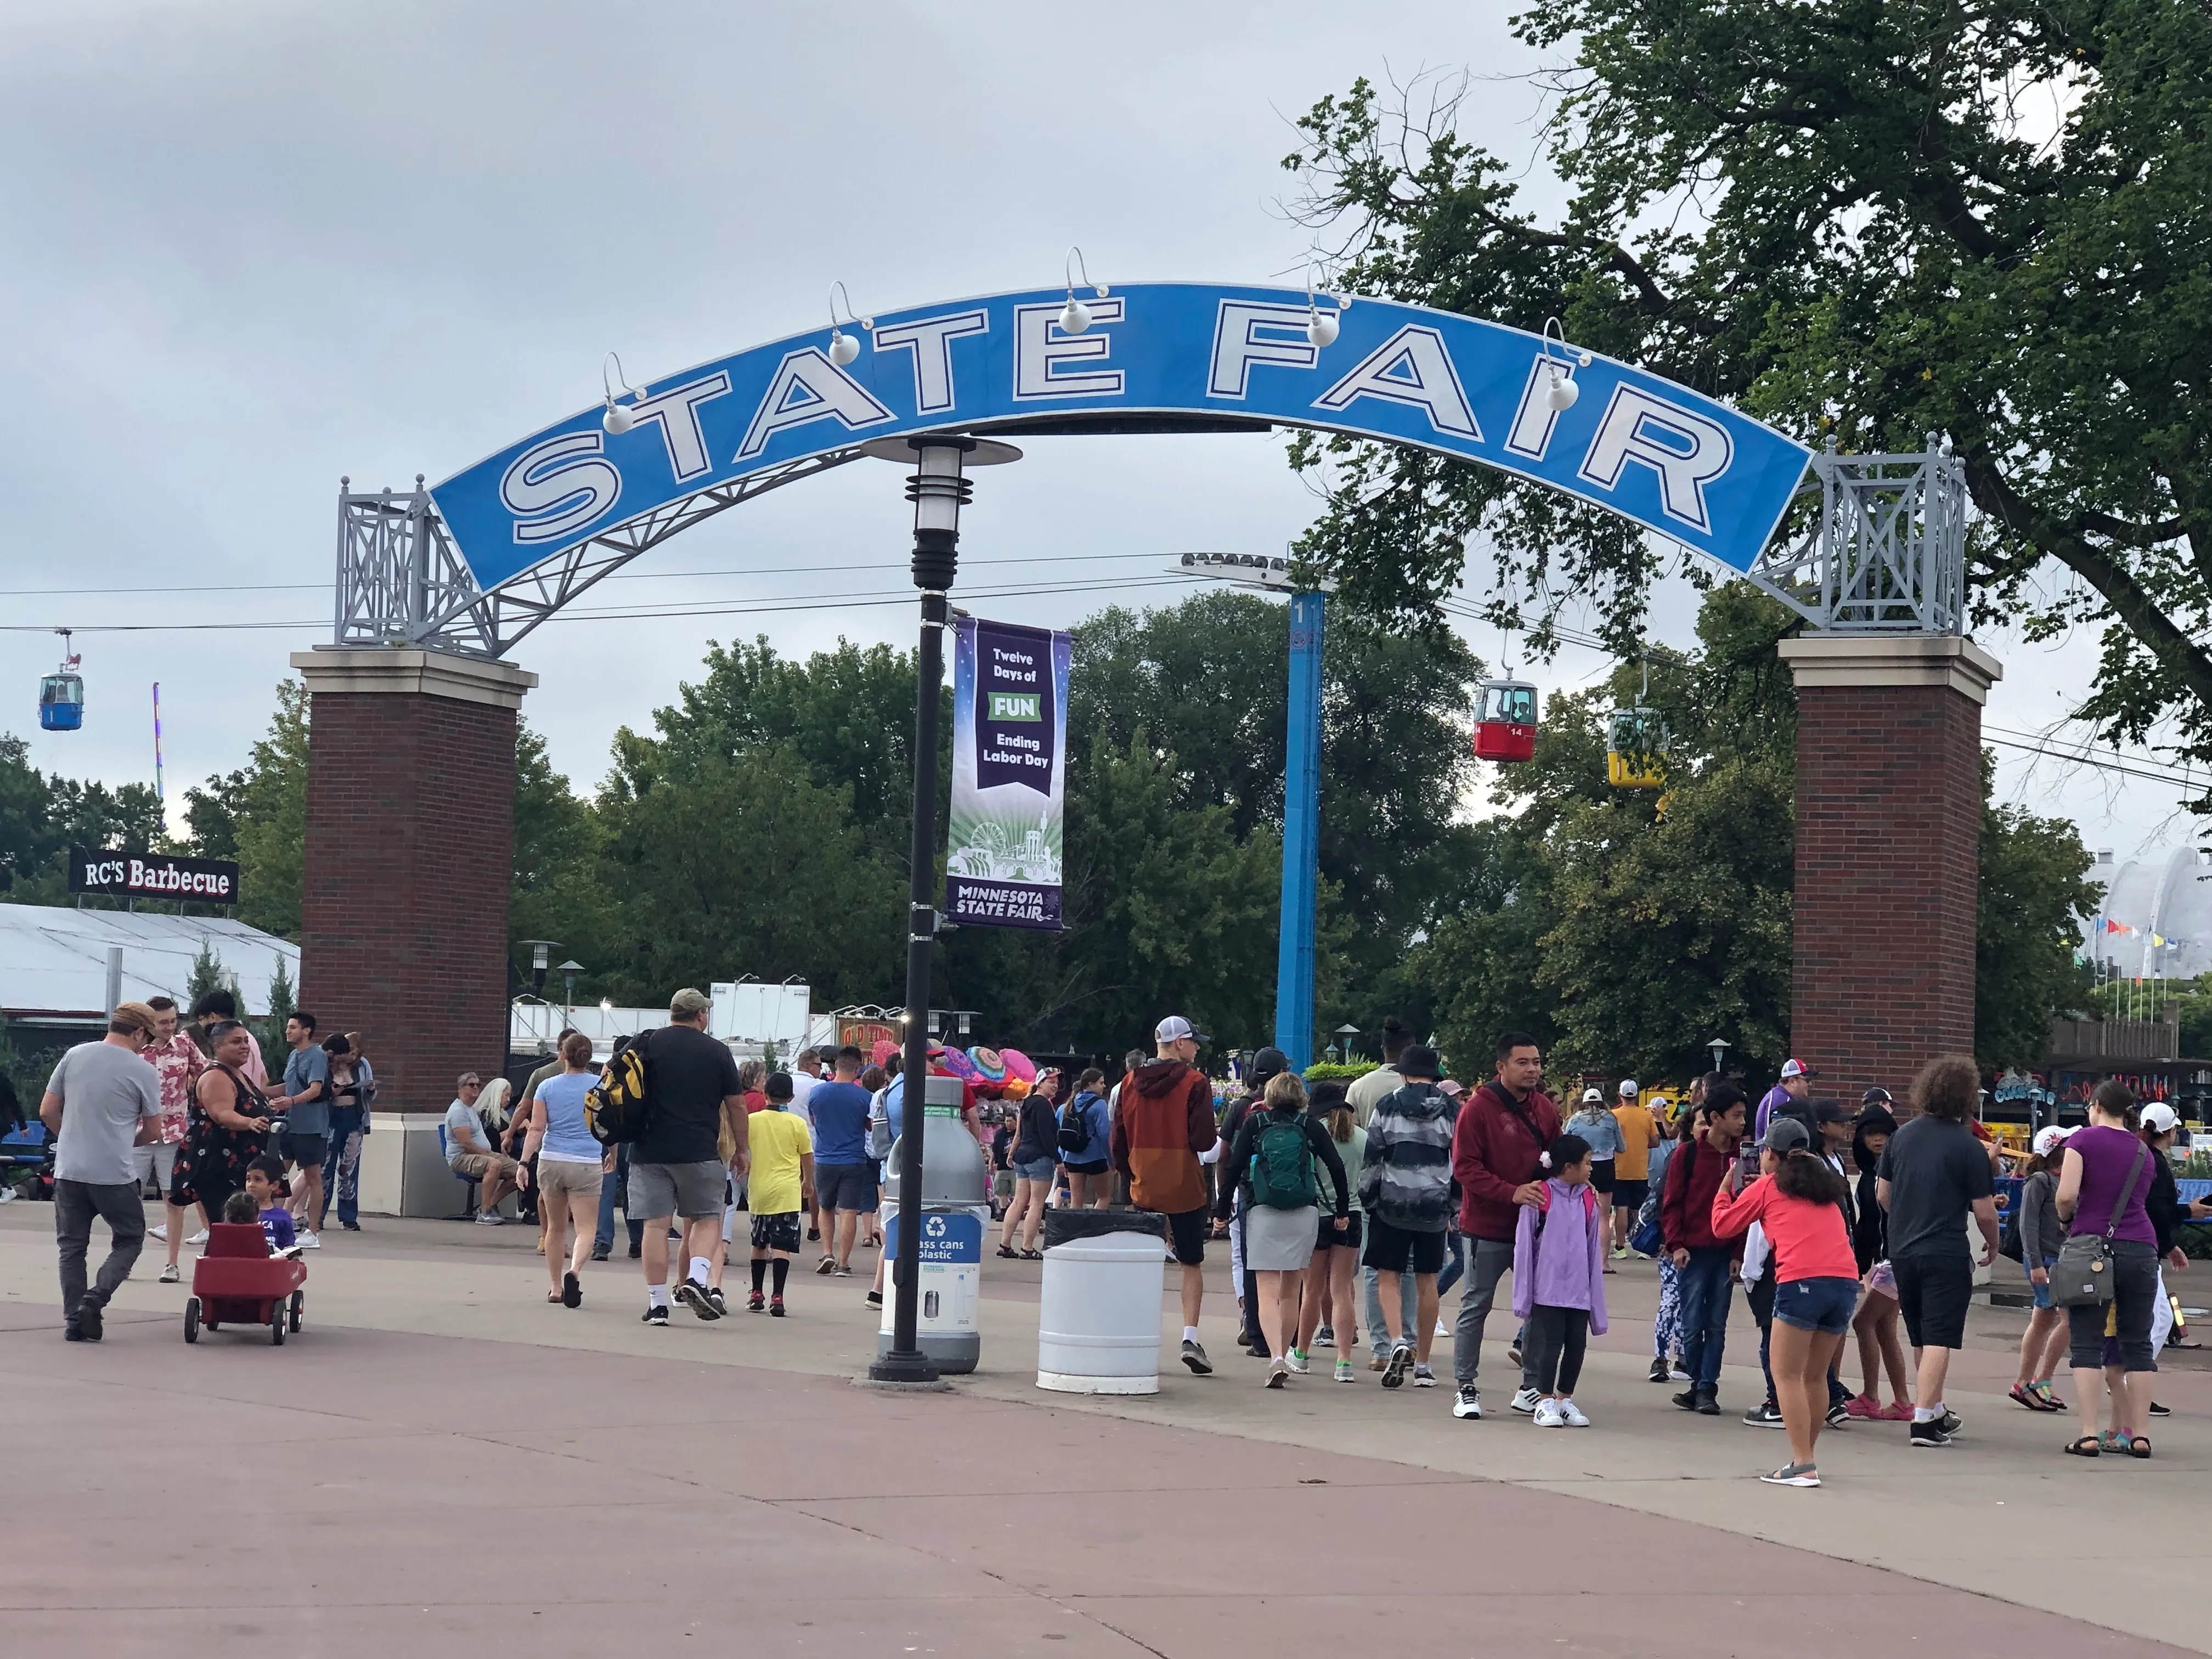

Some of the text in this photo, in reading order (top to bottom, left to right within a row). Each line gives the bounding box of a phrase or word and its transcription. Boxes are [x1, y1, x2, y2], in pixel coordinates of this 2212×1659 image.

[499, 297, 1735, 545] STATE FAIR
[1294, 601, 1303, 623] 1
[993, 647, 1033, 665] Twelve
[994, 665, 1036, 682] Days of
[995, 697, 1035, 716] FUN
[1510, 728, 1522, 736] 14
[997, 733, 1040, 752] Ending
[983, 749, 1048, 769] Labor Day
[85, 859, 229, 895] RC'S Barbecue
[958, 885, 1043, 905] MINNESOTA
[957, 900, 1053, 922] STATE FAIR
[844, 1024, 865, 1045] OD
[939, 1241, 964, 1250] cans
